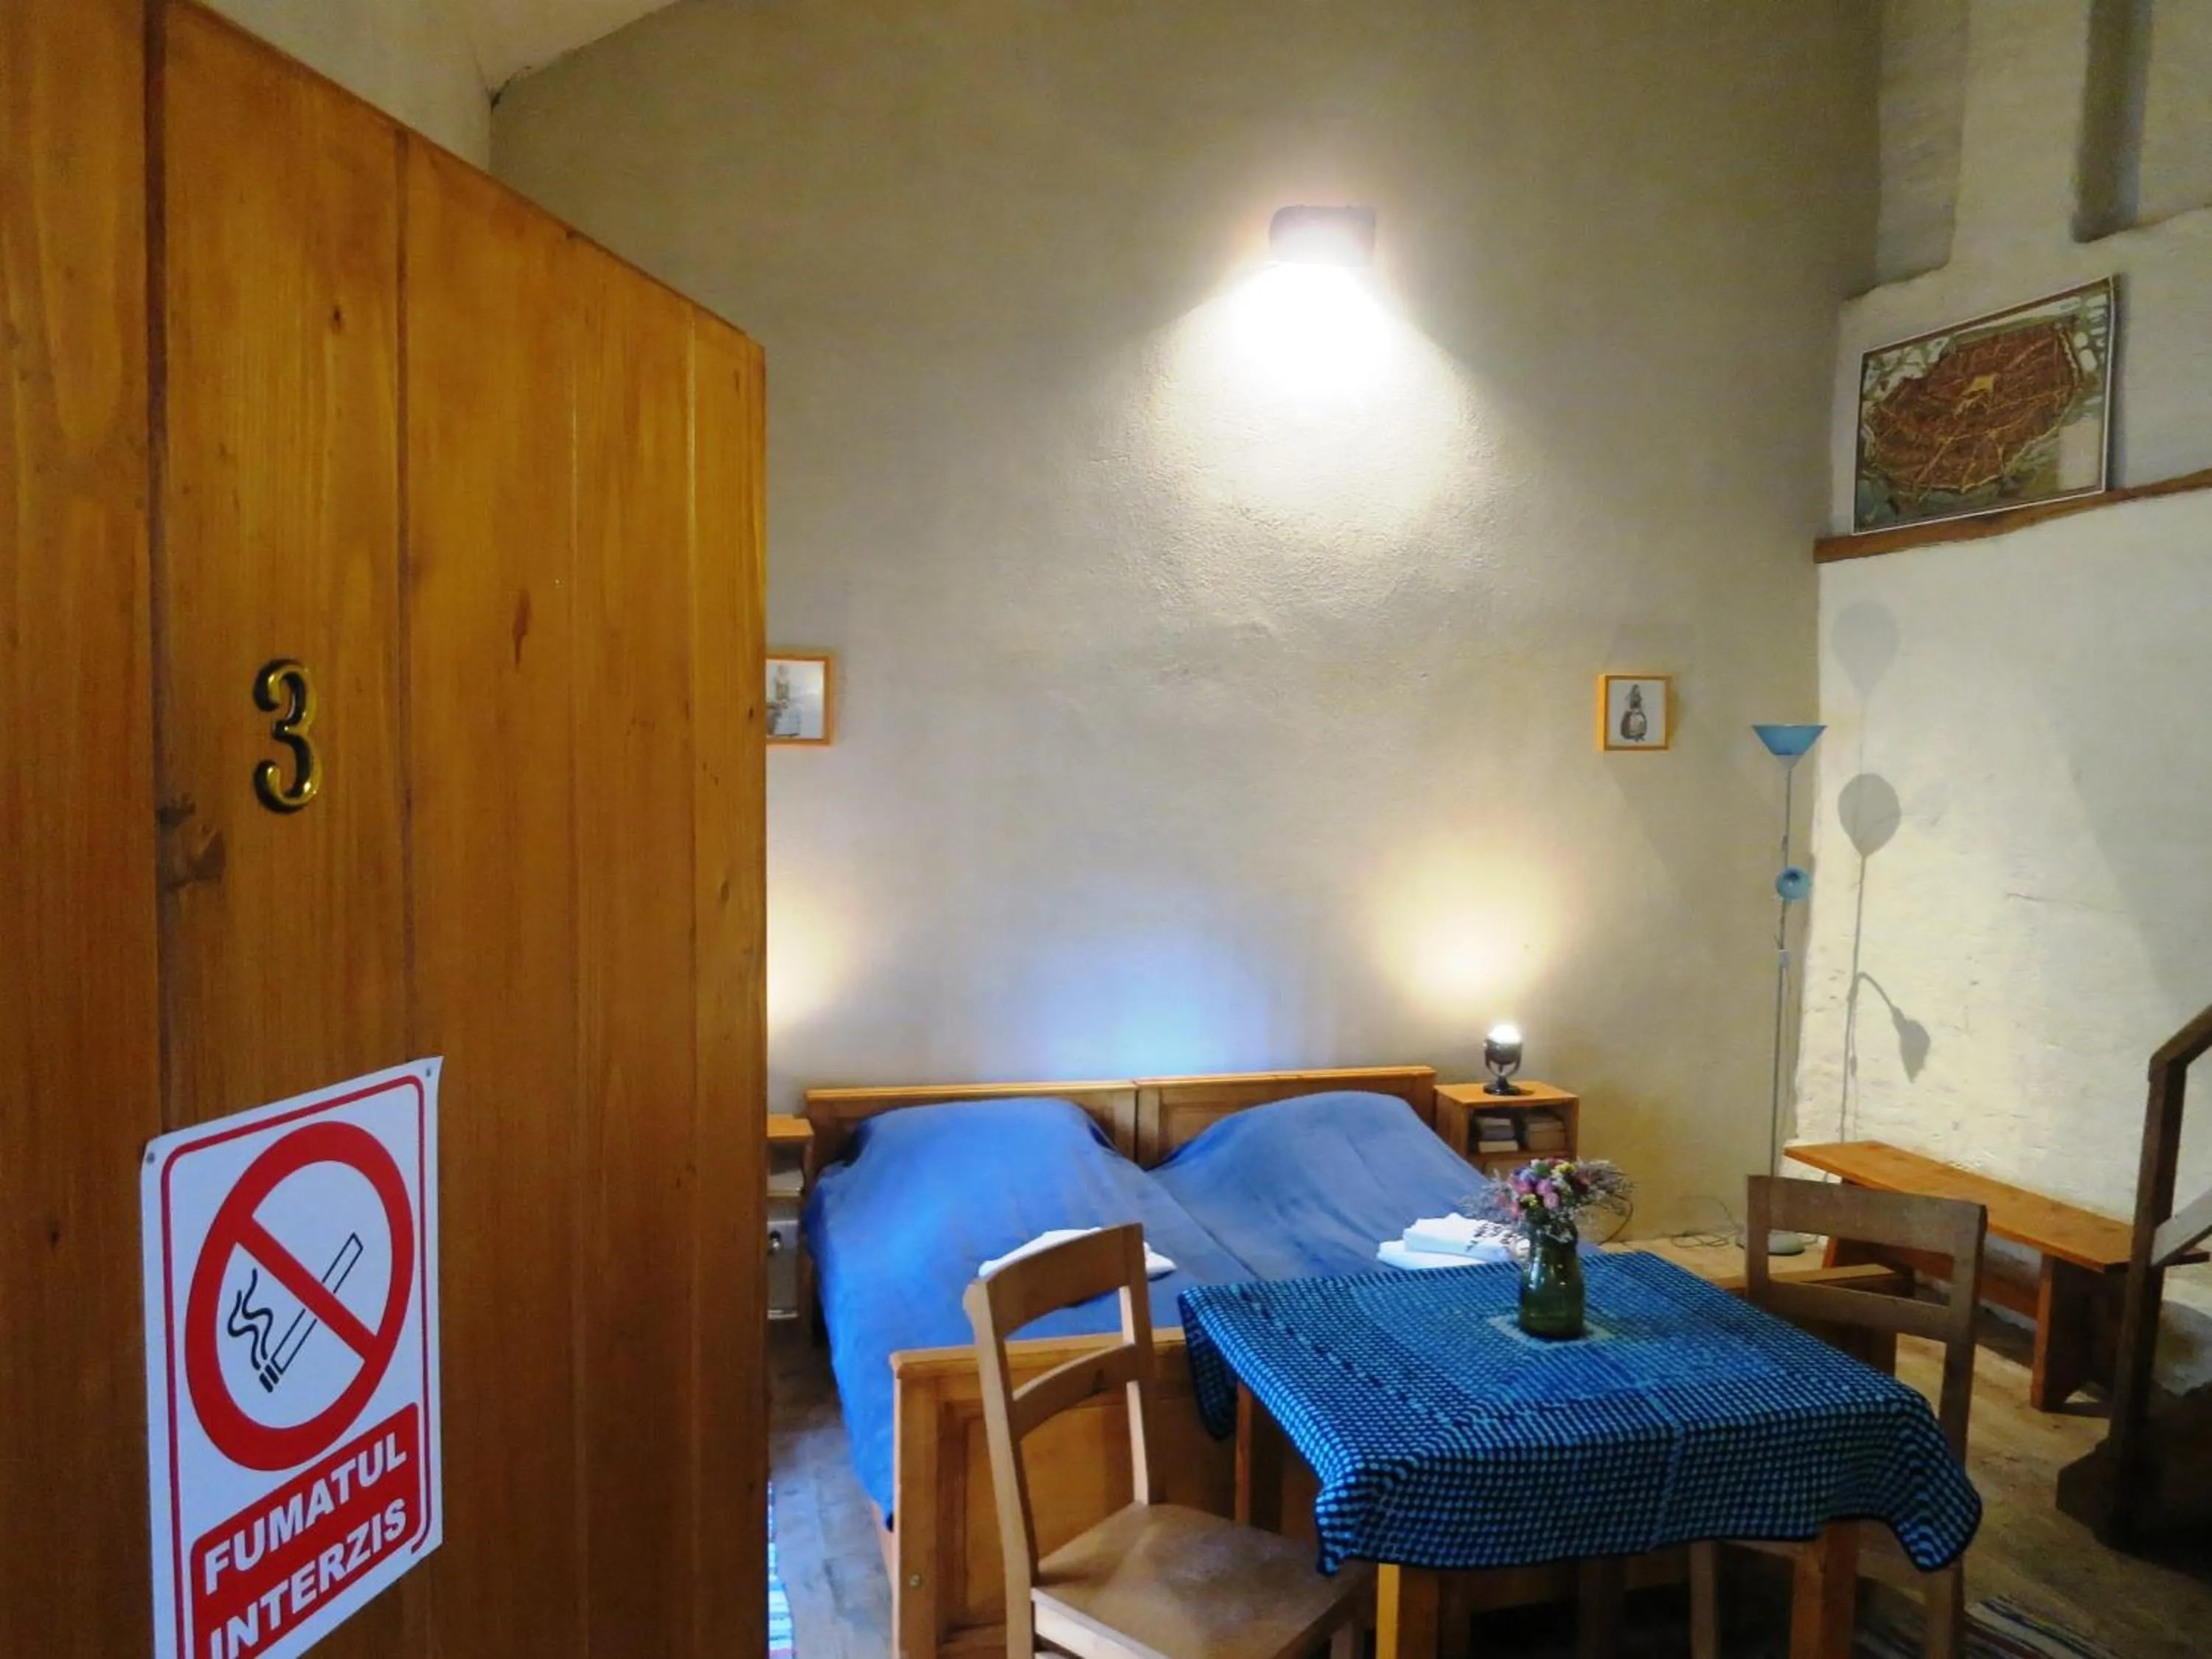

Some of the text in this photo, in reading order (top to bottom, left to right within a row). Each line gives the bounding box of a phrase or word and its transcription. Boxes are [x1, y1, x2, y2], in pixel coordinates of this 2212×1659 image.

[253, 659, 322, 814] 3
[204, 1433, 407, 1595] FUMATUL
[210, 1498, 406, 1659] INTERZIS
